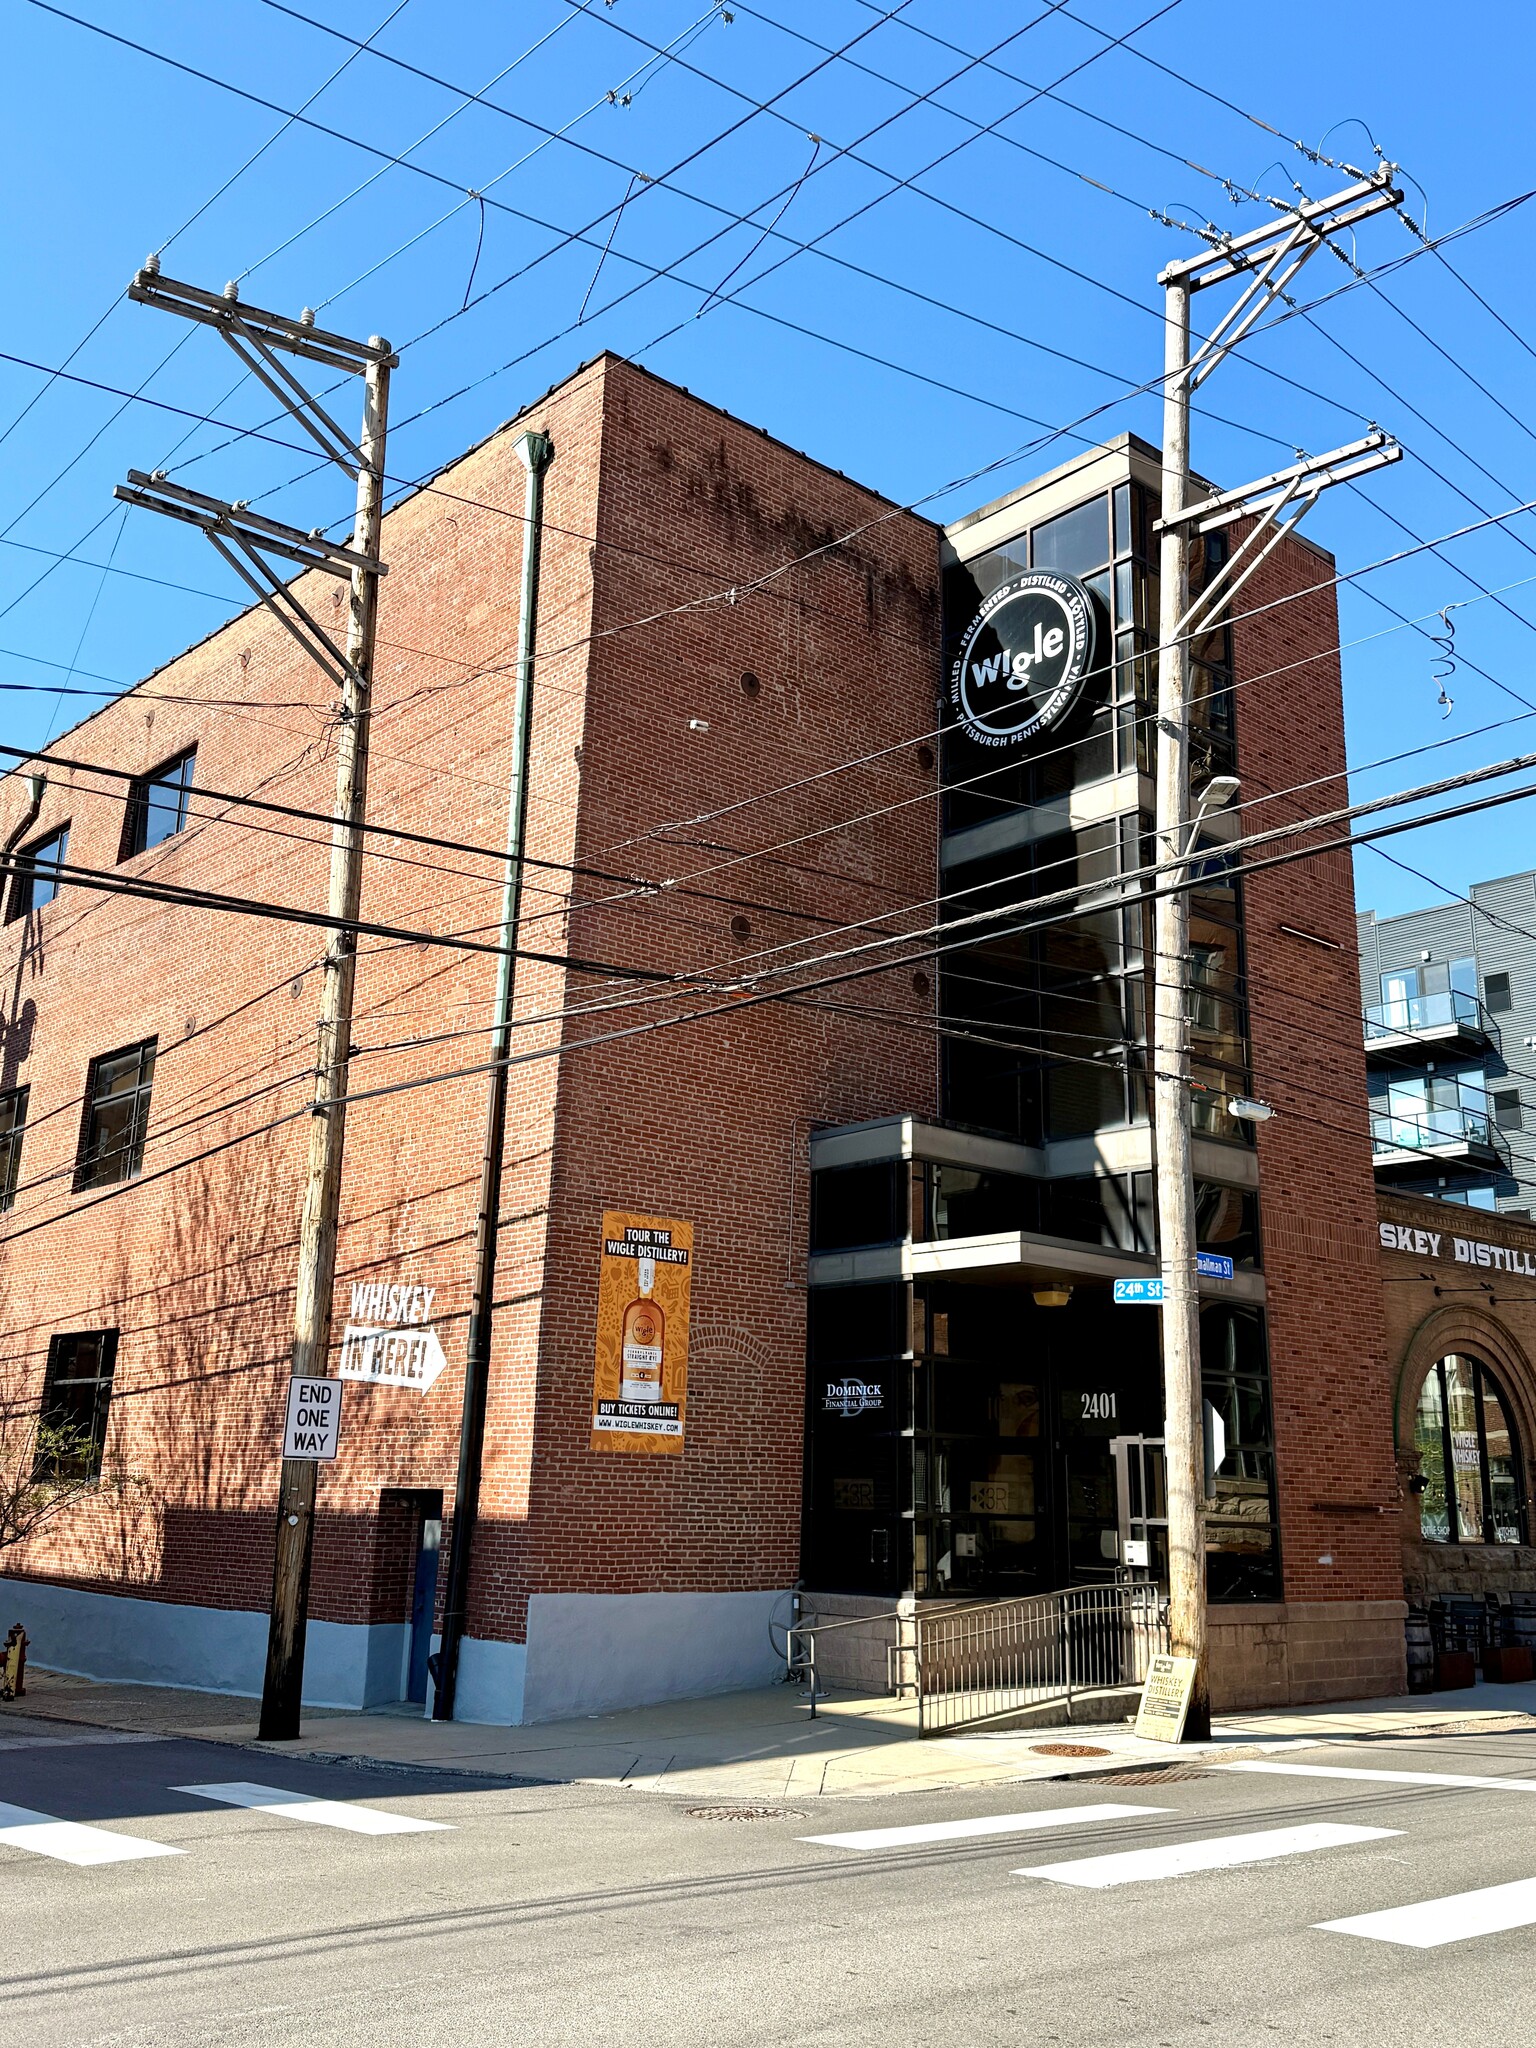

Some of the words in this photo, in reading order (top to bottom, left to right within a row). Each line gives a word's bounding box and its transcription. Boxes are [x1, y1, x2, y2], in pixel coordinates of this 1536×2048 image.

[1020, 575, 1067, 594] DISTILLED
[961, 586, 1011, 646] FERMENTED
[1068, 596, 1086, 650] BOTTLED
[972, 622, 1064, 691] wigle
[951, 661, 962, 703] MILLED
[626, 1229, 650, 1242] TOUR
[653, 1231, 670, 1244] THE
[607, 1241, 635, 1256] WIGLE
[637, 1245, 687, 1263] DISTILLERY!
[1378, 1222, 1441, 1257] SKEY
[1453, 1237, 1536, 1276] DISTILL
[1197, 1257, 1222, 1273] mallman
[1223, 1260, 1231, 1275] St
[1116, 1282, 1143, 1297] 24th
[1147, 1282, 1161, 1296] St
[351, 1282, 436, 1324] WHISKEY
[345, 1334, 366, 1371] IN
[371, 1336, 428, 1379] HERE!
[300, 1385, 332, 1404] END
[600, 1403, 616, 1414] BUY
[618, 1404, 646, 1416] TICKETS
[648, 1405, 678, 1417] ONLINE!
[1081, 1393, 1117, 1418] 2401
[296, 1408, 330, 1427] ONE
[598, 1419, 679, 1432] WWW.WIGLEWHISKEY.COM
[294, 1432, 329, 1451] WAY
[1454, 1449, 1480, 1464] WHISKEY
